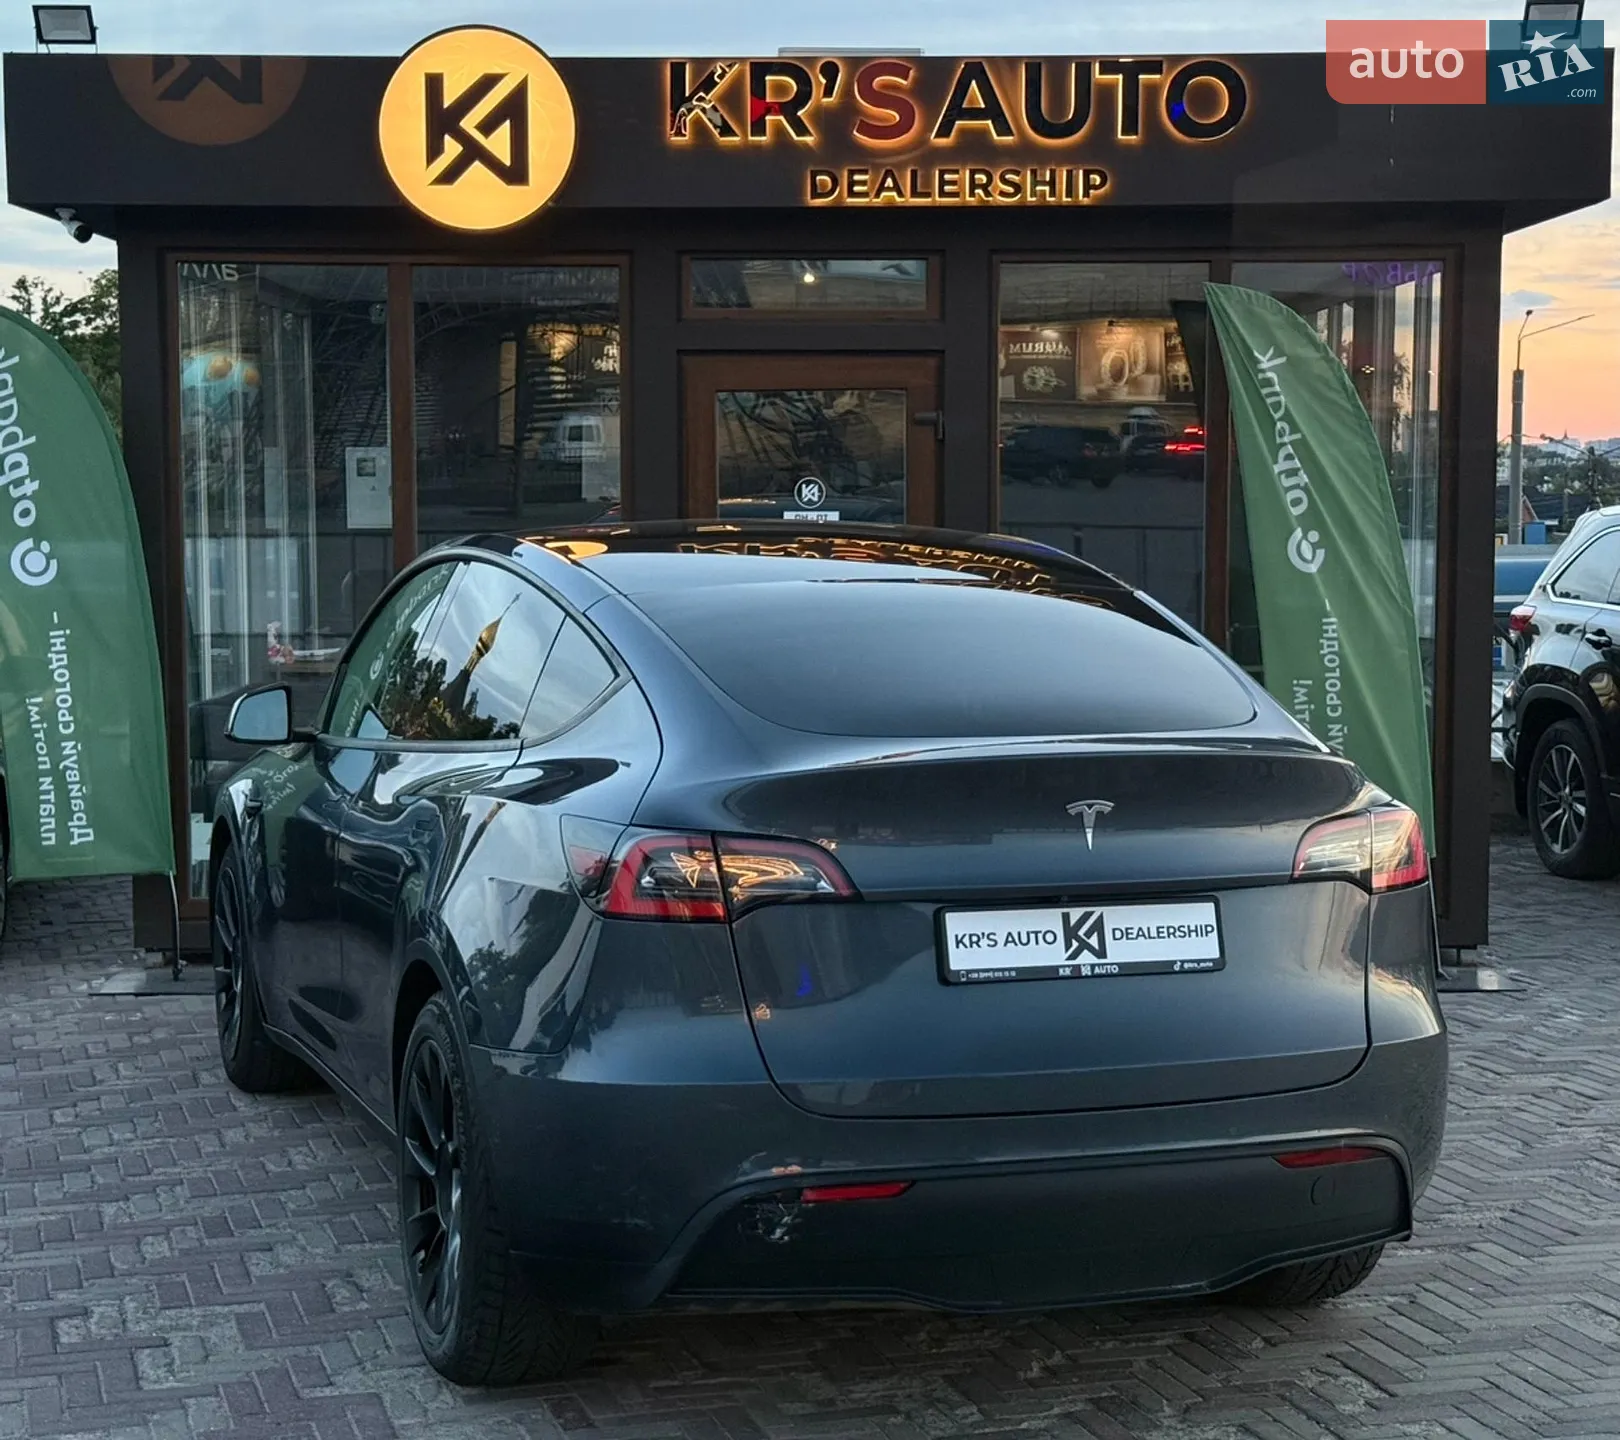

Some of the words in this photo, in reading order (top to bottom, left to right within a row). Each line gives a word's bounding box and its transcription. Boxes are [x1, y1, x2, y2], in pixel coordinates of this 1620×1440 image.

[933, 60, 1248, 141] AUTO
[809, 168, 1109, 202] DEALERSHIP
[955, 932, 998, 950] KR'S
[1003, 929, 1058, 947] AUTO
[1111, 923, 1215, 941] DEALERSHIP
[1094, 964, 1119, 974] AUTO
